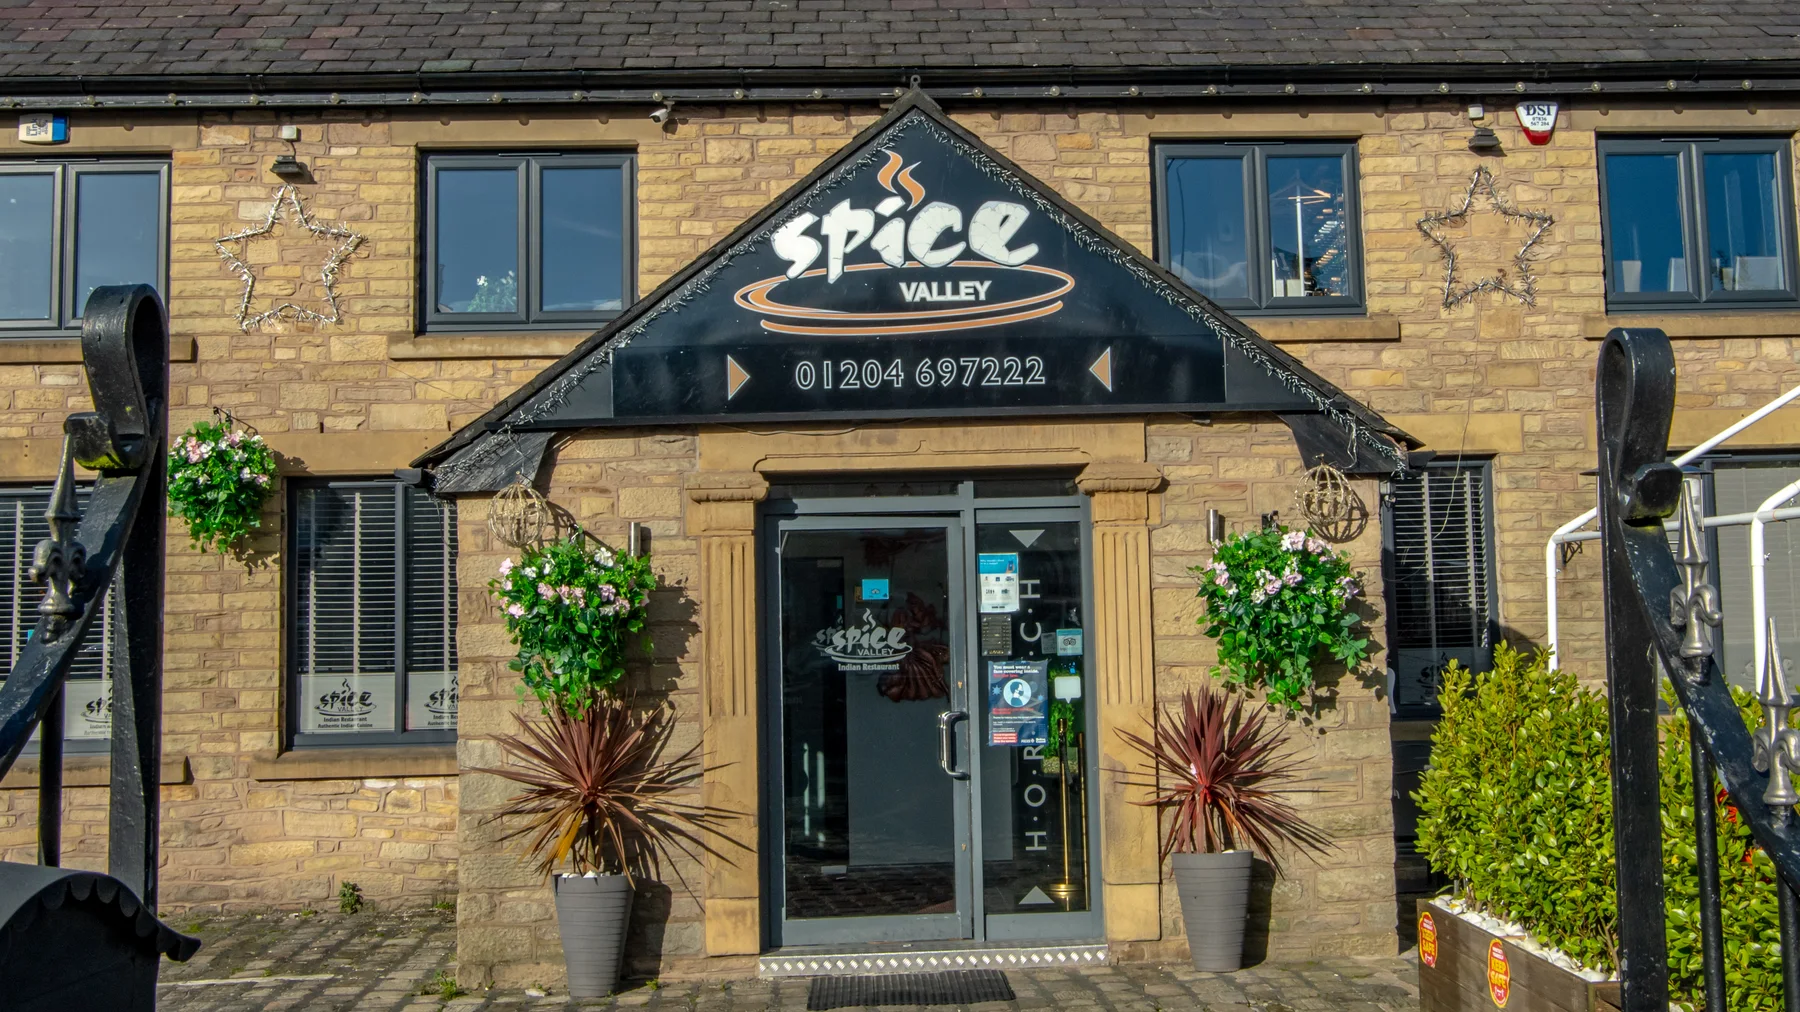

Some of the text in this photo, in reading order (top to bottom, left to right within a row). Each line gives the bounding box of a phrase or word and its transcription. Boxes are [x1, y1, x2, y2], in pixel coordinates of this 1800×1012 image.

[1526, 104, 1551, 116] DSI
[899, 280, 992, 302] VALLEY
[795, 356, 1045, 389] 01204 697222
[857, 648, 895, 656] VALLEY
[838, 663, 900, 671] Indian Restaurant
